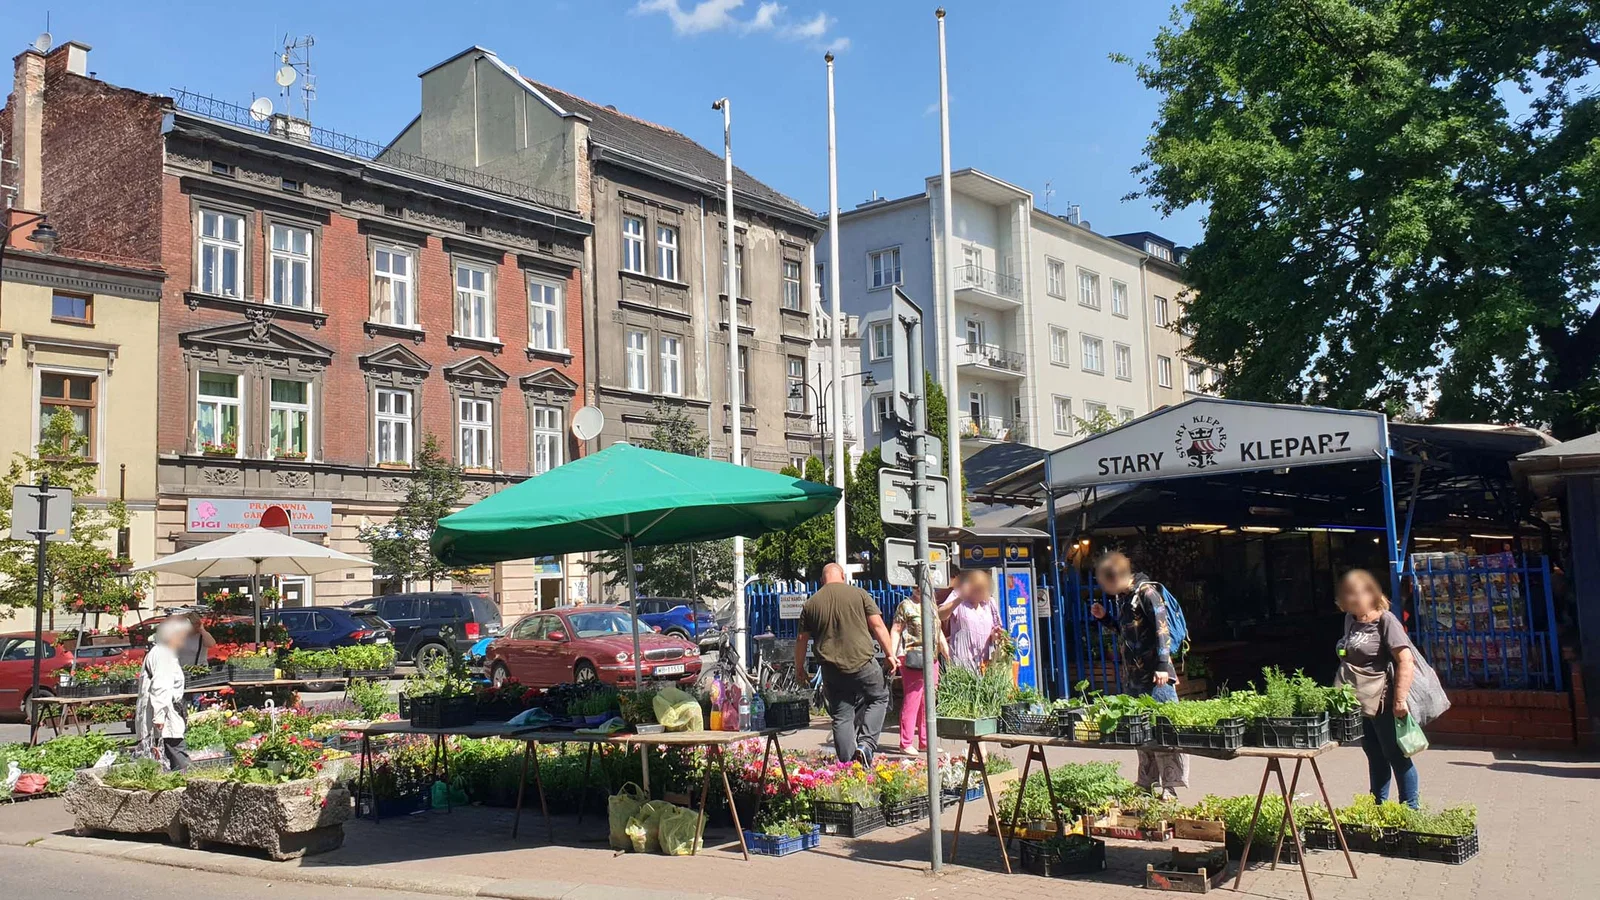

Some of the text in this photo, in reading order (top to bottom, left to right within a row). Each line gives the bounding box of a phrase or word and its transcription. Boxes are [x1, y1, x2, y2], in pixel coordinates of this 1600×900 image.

[1175, 415, 1227, 459] STARY KLEPARZ
[1098, 431, 1351, 475] STARY KLEPARZ
[191, 520, 222, 529] PIGI
[244, 511, 315, 520] GARYJNA
